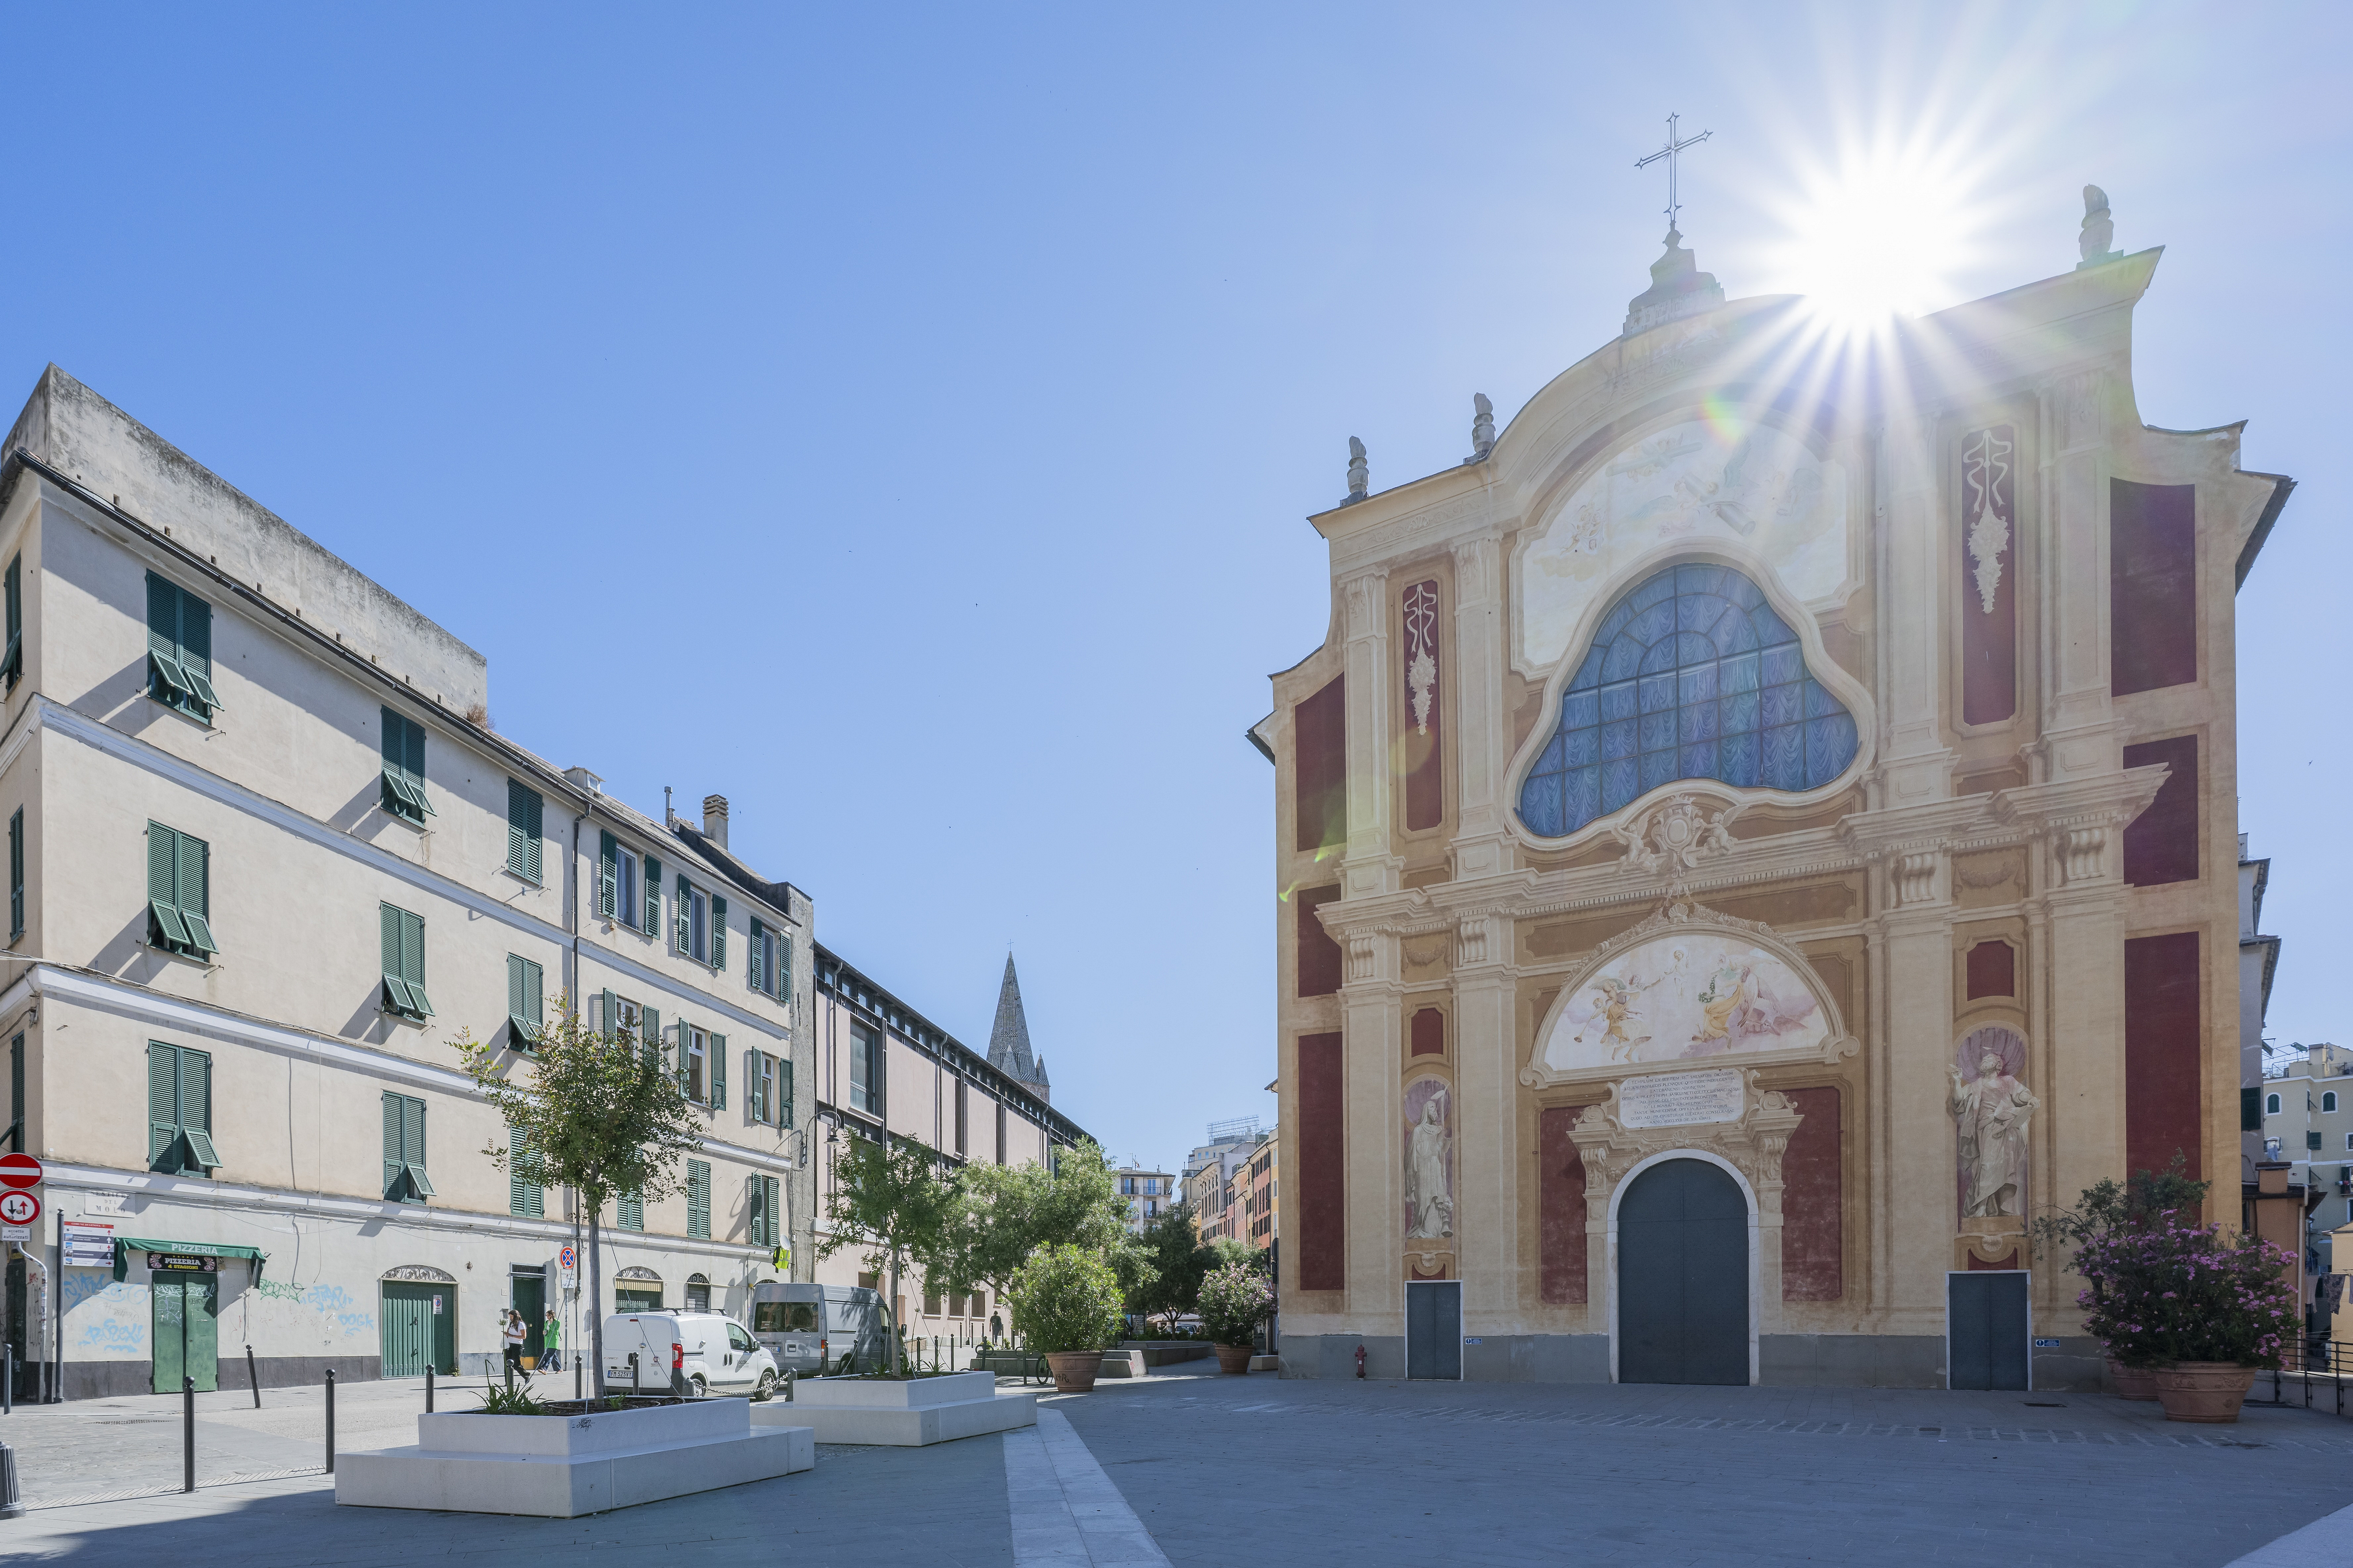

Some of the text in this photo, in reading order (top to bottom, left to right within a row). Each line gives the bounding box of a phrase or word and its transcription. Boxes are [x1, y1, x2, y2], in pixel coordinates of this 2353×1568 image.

[95, 1205, 125, 1214] MOLO
[172, 1243, 218, 1255] PIZZERIA
[164, 1257, 201, 1265] PIZZERIA
